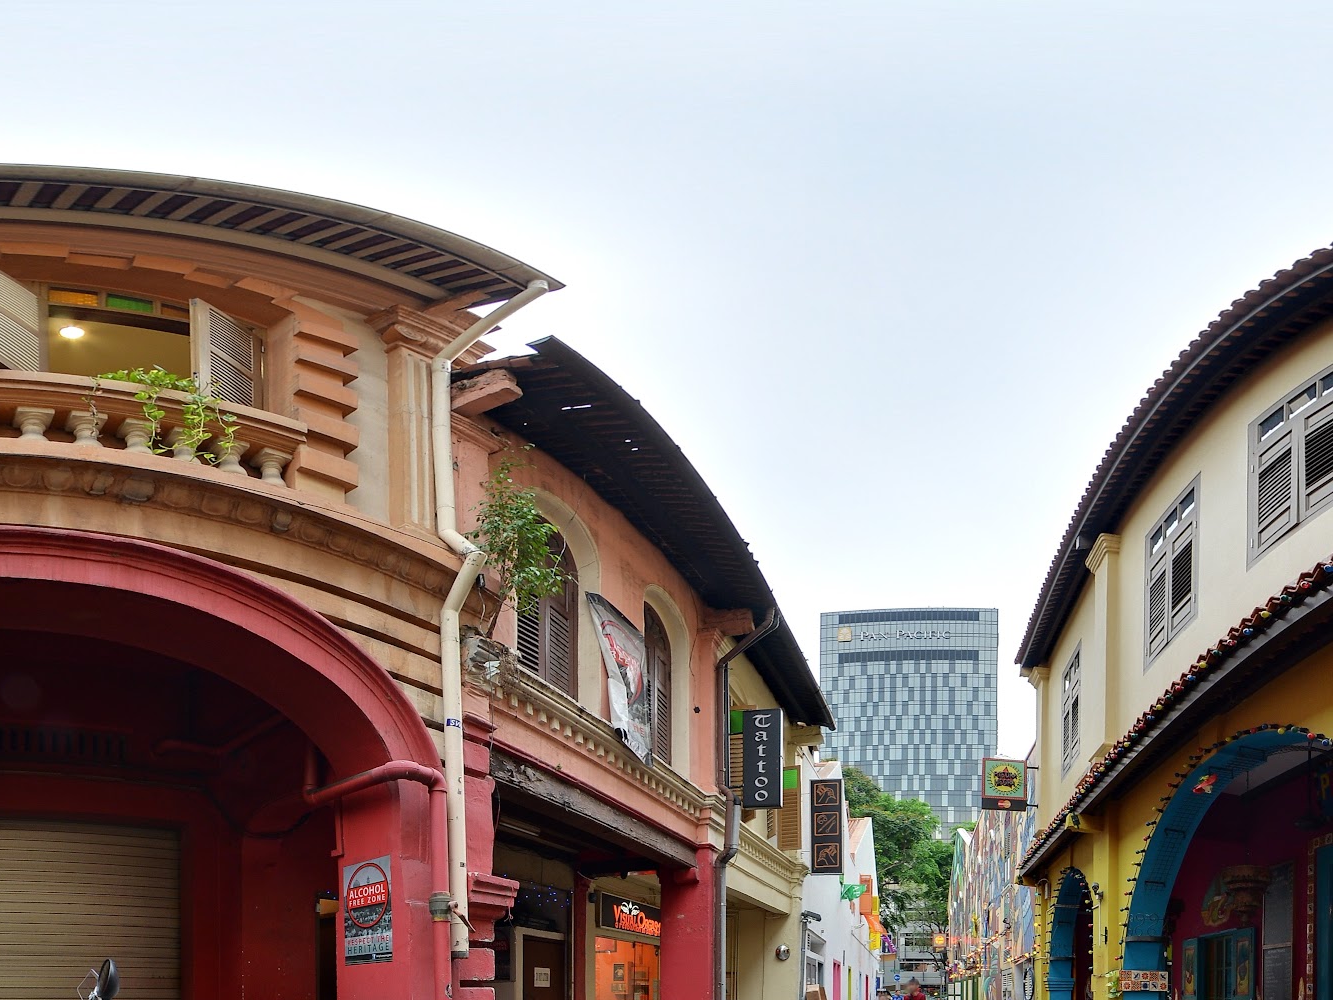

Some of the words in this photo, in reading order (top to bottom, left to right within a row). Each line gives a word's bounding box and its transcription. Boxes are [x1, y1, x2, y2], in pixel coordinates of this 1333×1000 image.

[860, 631, 889, 641] PAN
[896, 629, 951, 640] PACIFIC
[752, 714, 772, 801] Tattoo
[349, 883, 386, 900] ALCOHOL
[349, 898, 364, 907] FREE
[367, 893, 386, 904] ZONE
[348, 936, 374, 946] RESPECT
[377, 934, 389, 943] THE
[347, 943, 390, 955] HERITAGE
